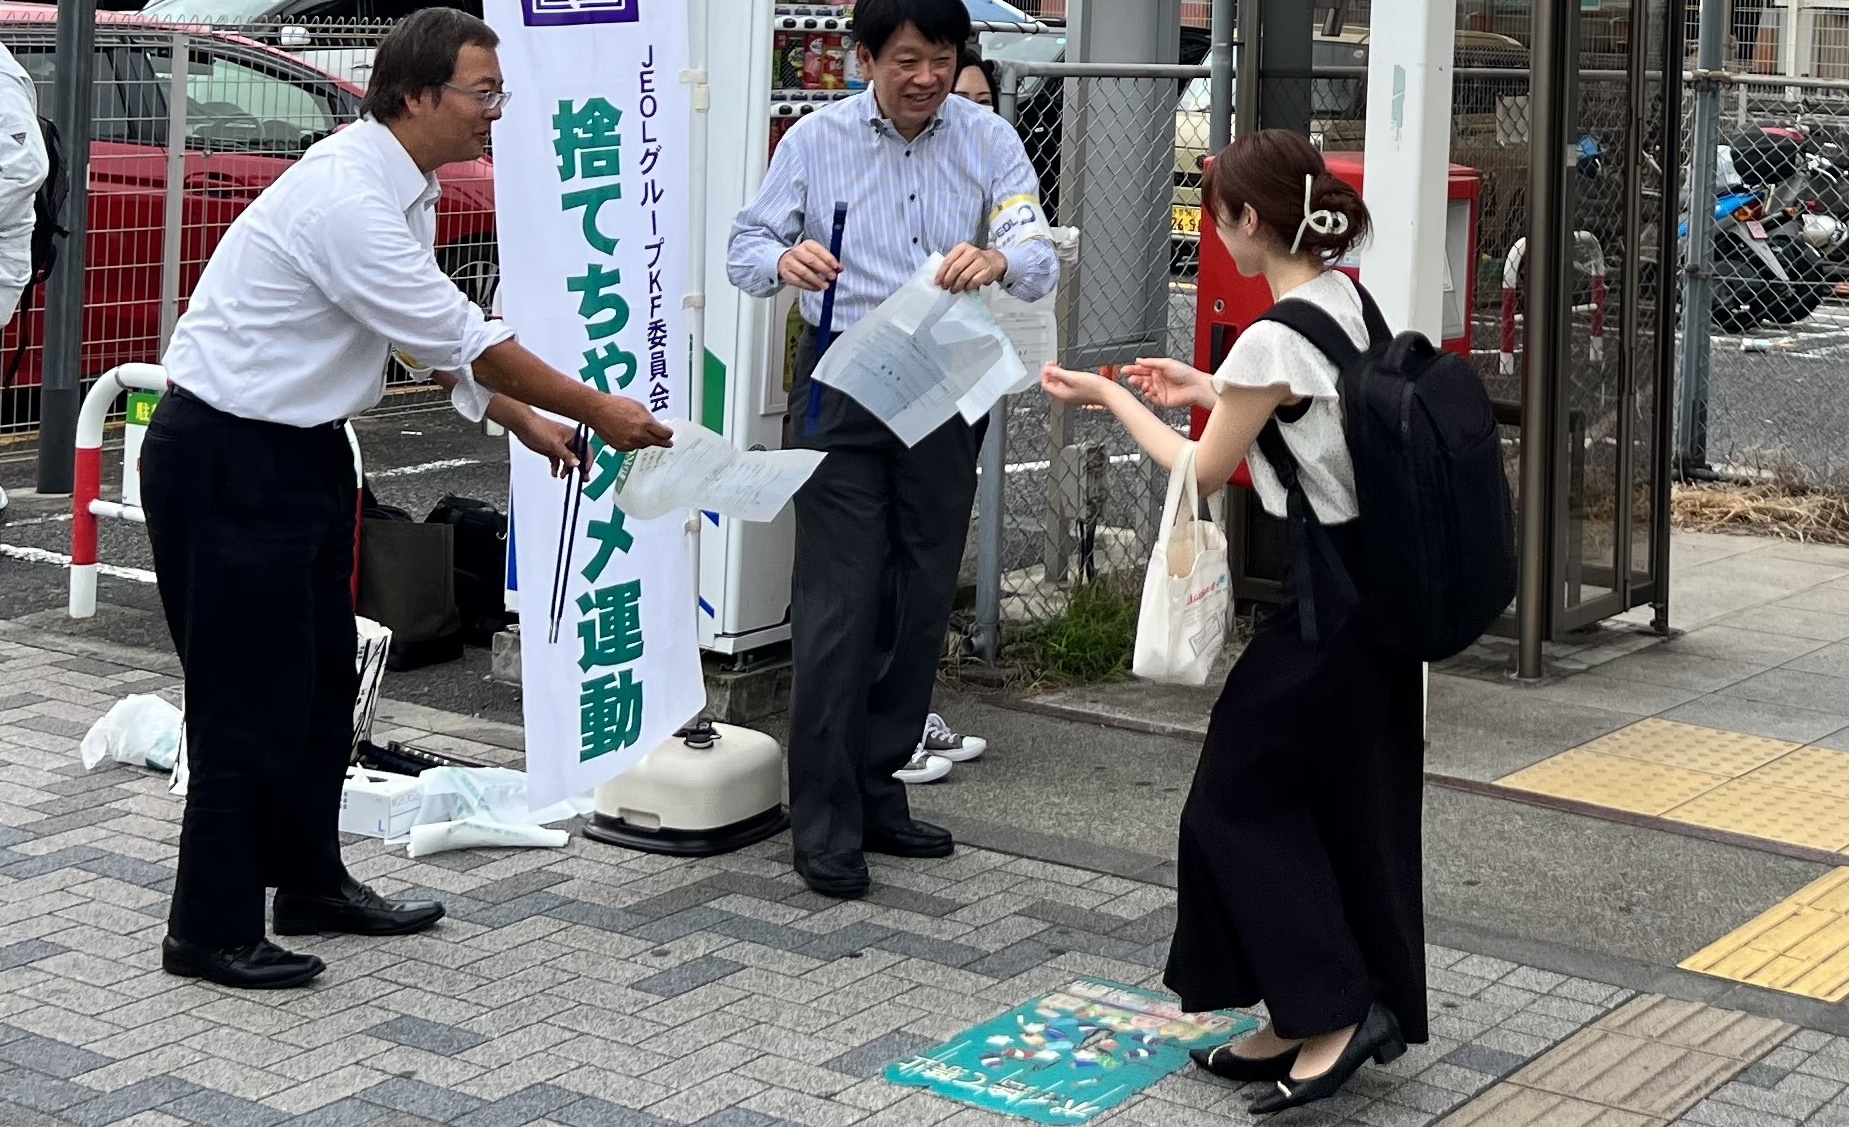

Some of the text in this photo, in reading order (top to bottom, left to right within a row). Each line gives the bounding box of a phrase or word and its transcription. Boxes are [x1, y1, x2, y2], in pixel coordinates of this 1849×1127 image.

[638, 44, 670, 413] JEOLグループKF委員会
